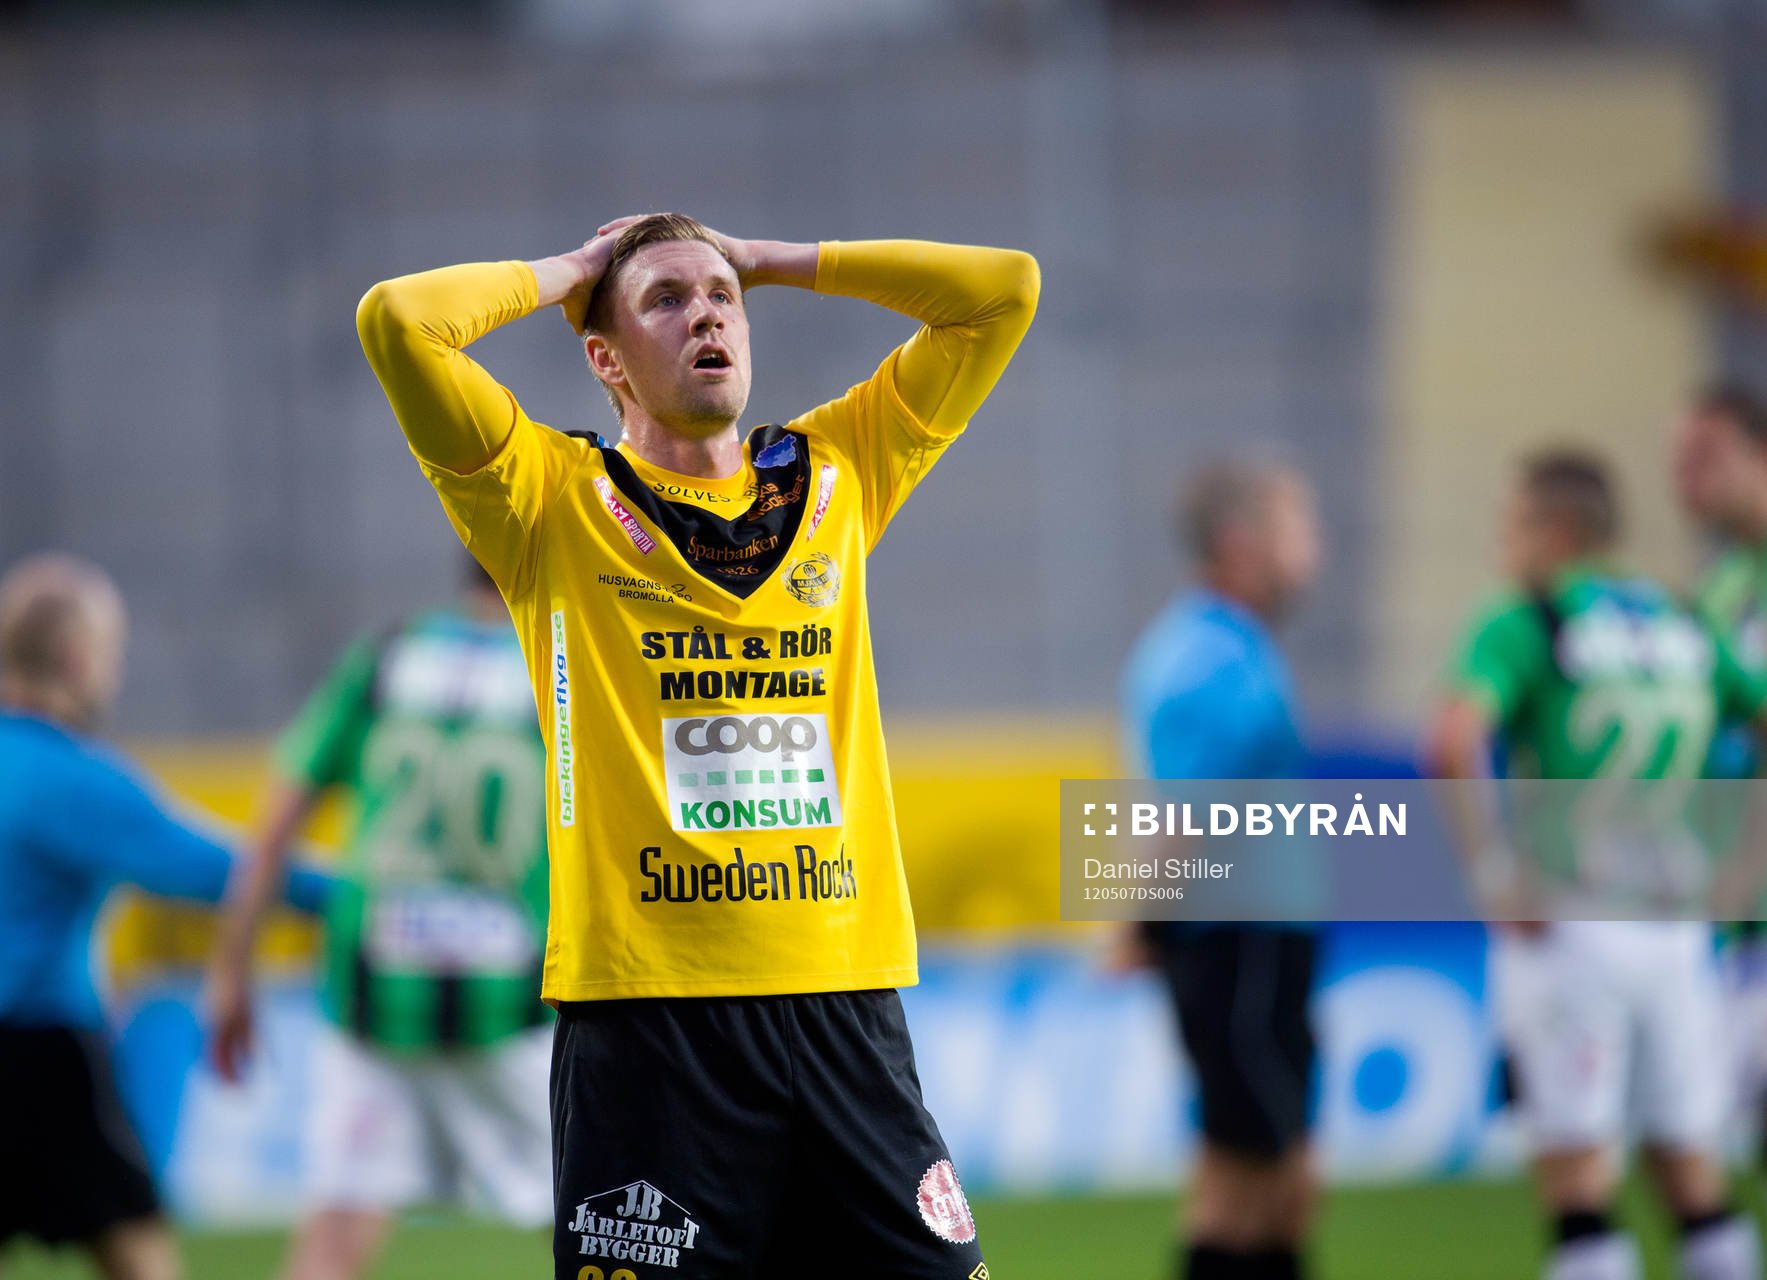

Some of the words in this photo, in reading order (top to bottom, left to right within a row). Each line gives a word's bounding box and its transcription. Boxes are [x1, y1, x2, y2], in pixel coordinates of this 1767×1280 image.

[624, 518, 655, 552] SPORTIA
[687, 535, 780, 562] Sparbanken
[641, 625, 733, 660] STÅL
[741, 637, 771, 660] &
[779, 624, 832, 659] RÖR
[660, 668, 827, 700] MONTAGE
[554, 613, 575, 822] blekingeflyg.se
[674, 716, 818, 762] coop
[680, 797, 833, 829] KONSUM
[639, 846, 791, 903] Sweden
[794, 842, 858, 903] Rock
[567, 1202, 701, 1250] JÄRLETOFT
[578, 1234, 681, 1268] BYGGER
